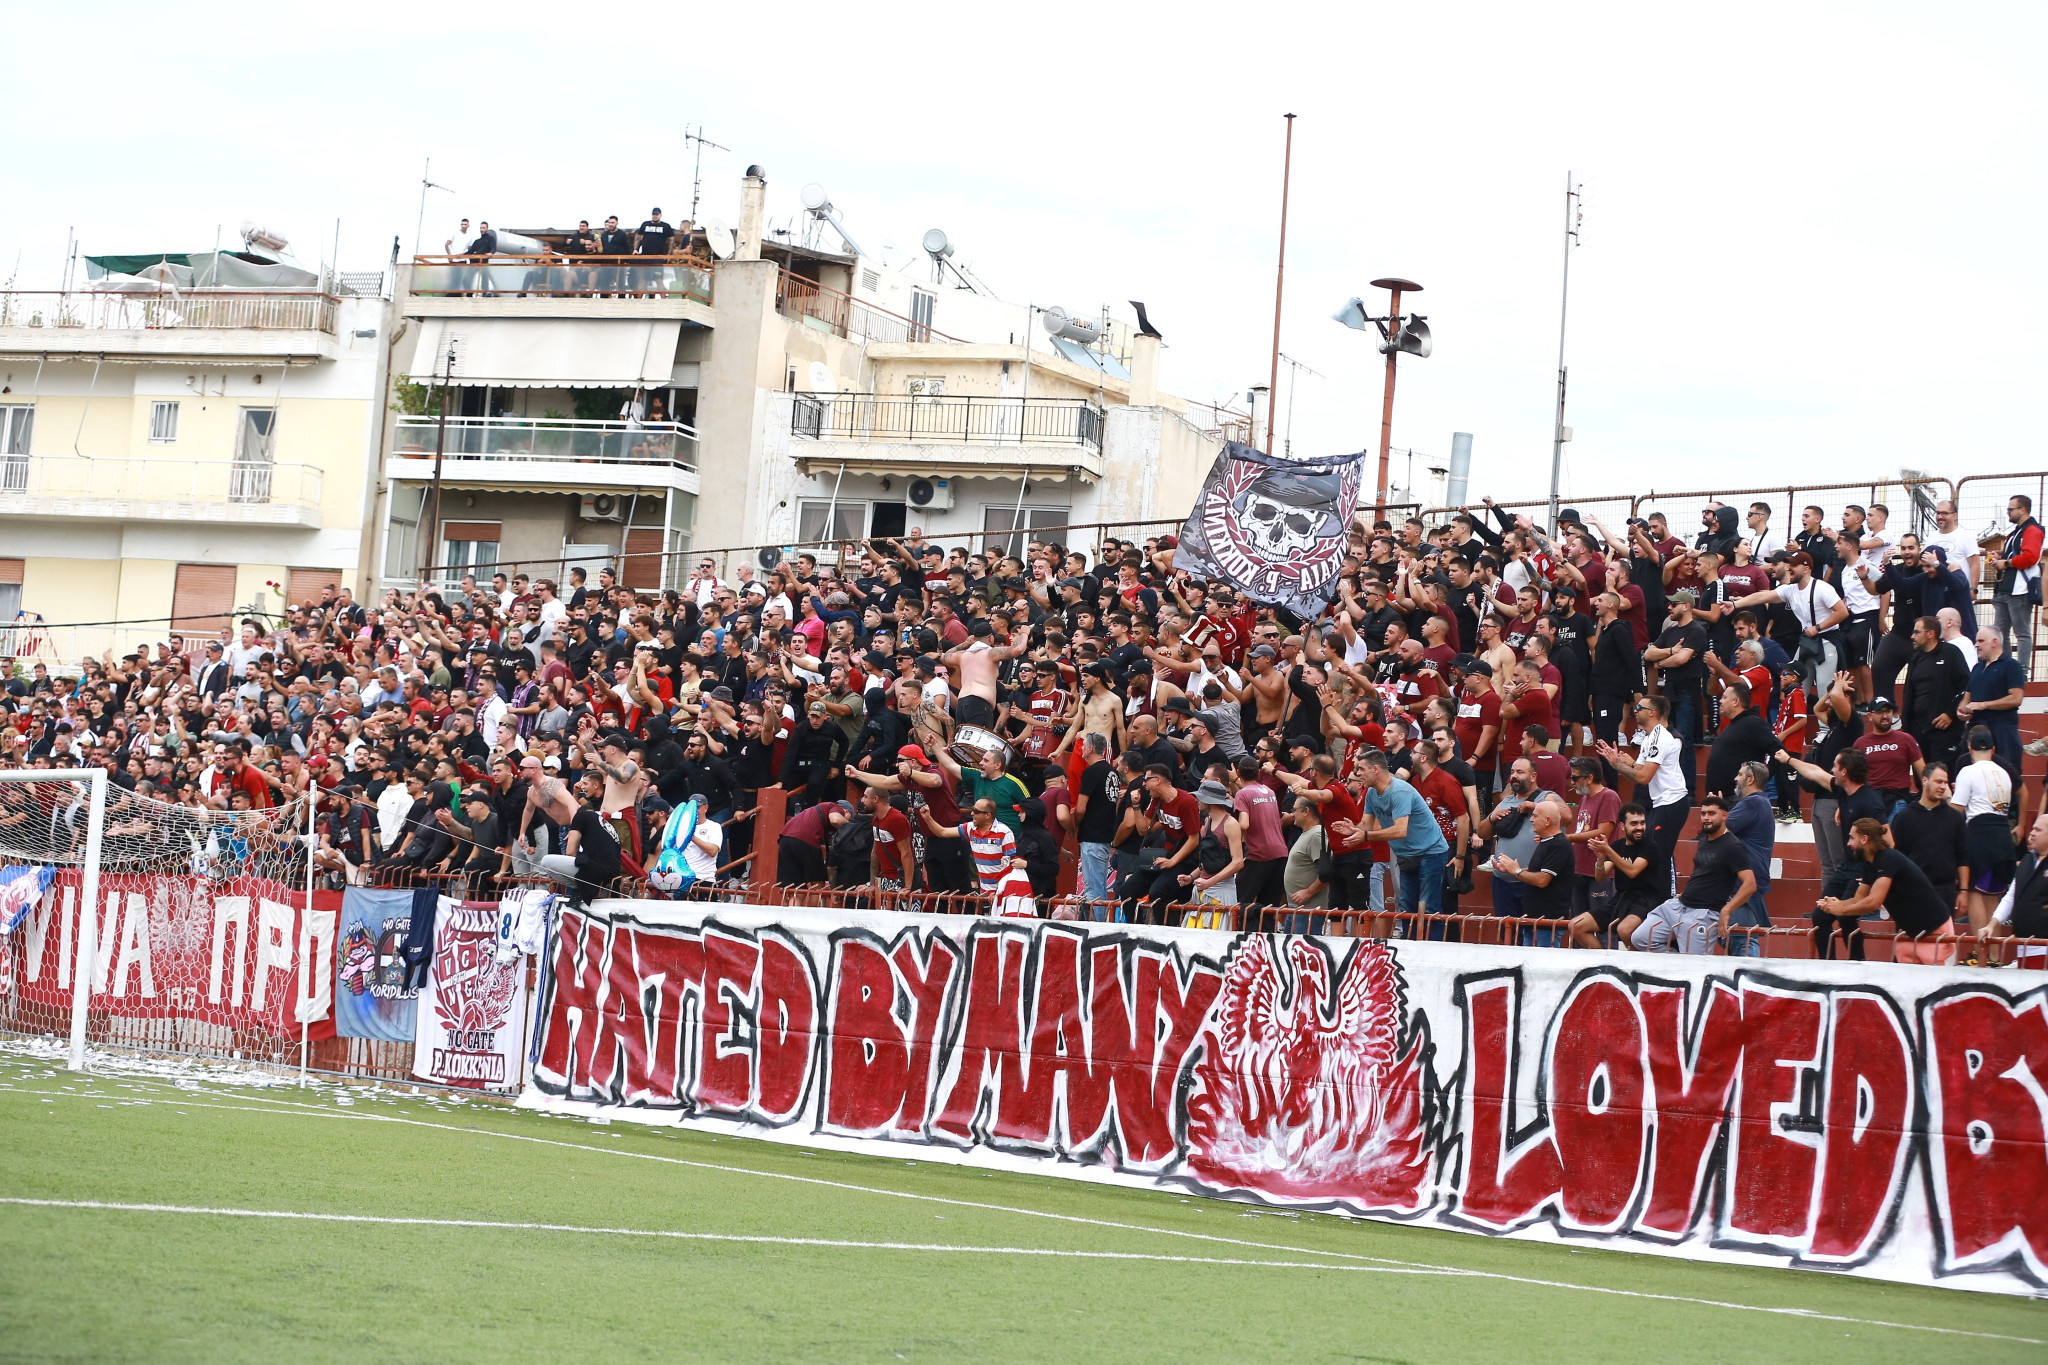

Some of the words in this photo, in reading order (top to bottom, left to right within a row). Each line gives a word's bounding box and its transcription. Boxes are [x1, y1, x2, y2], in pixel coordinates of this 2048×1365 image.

[450, 907, 498, 932] NIKAI
[501, 912, 511, 939] 8
[448, 1030, 463, 1047] NO
[467, 1031, 496, 1050] GATE
[531, 906, 820, 1128] HATED
[816, 926, 962, 1147] BY
[934, 920, 1226, 1175] MANY
[1440, 966, 1916, 1269] LOVED
